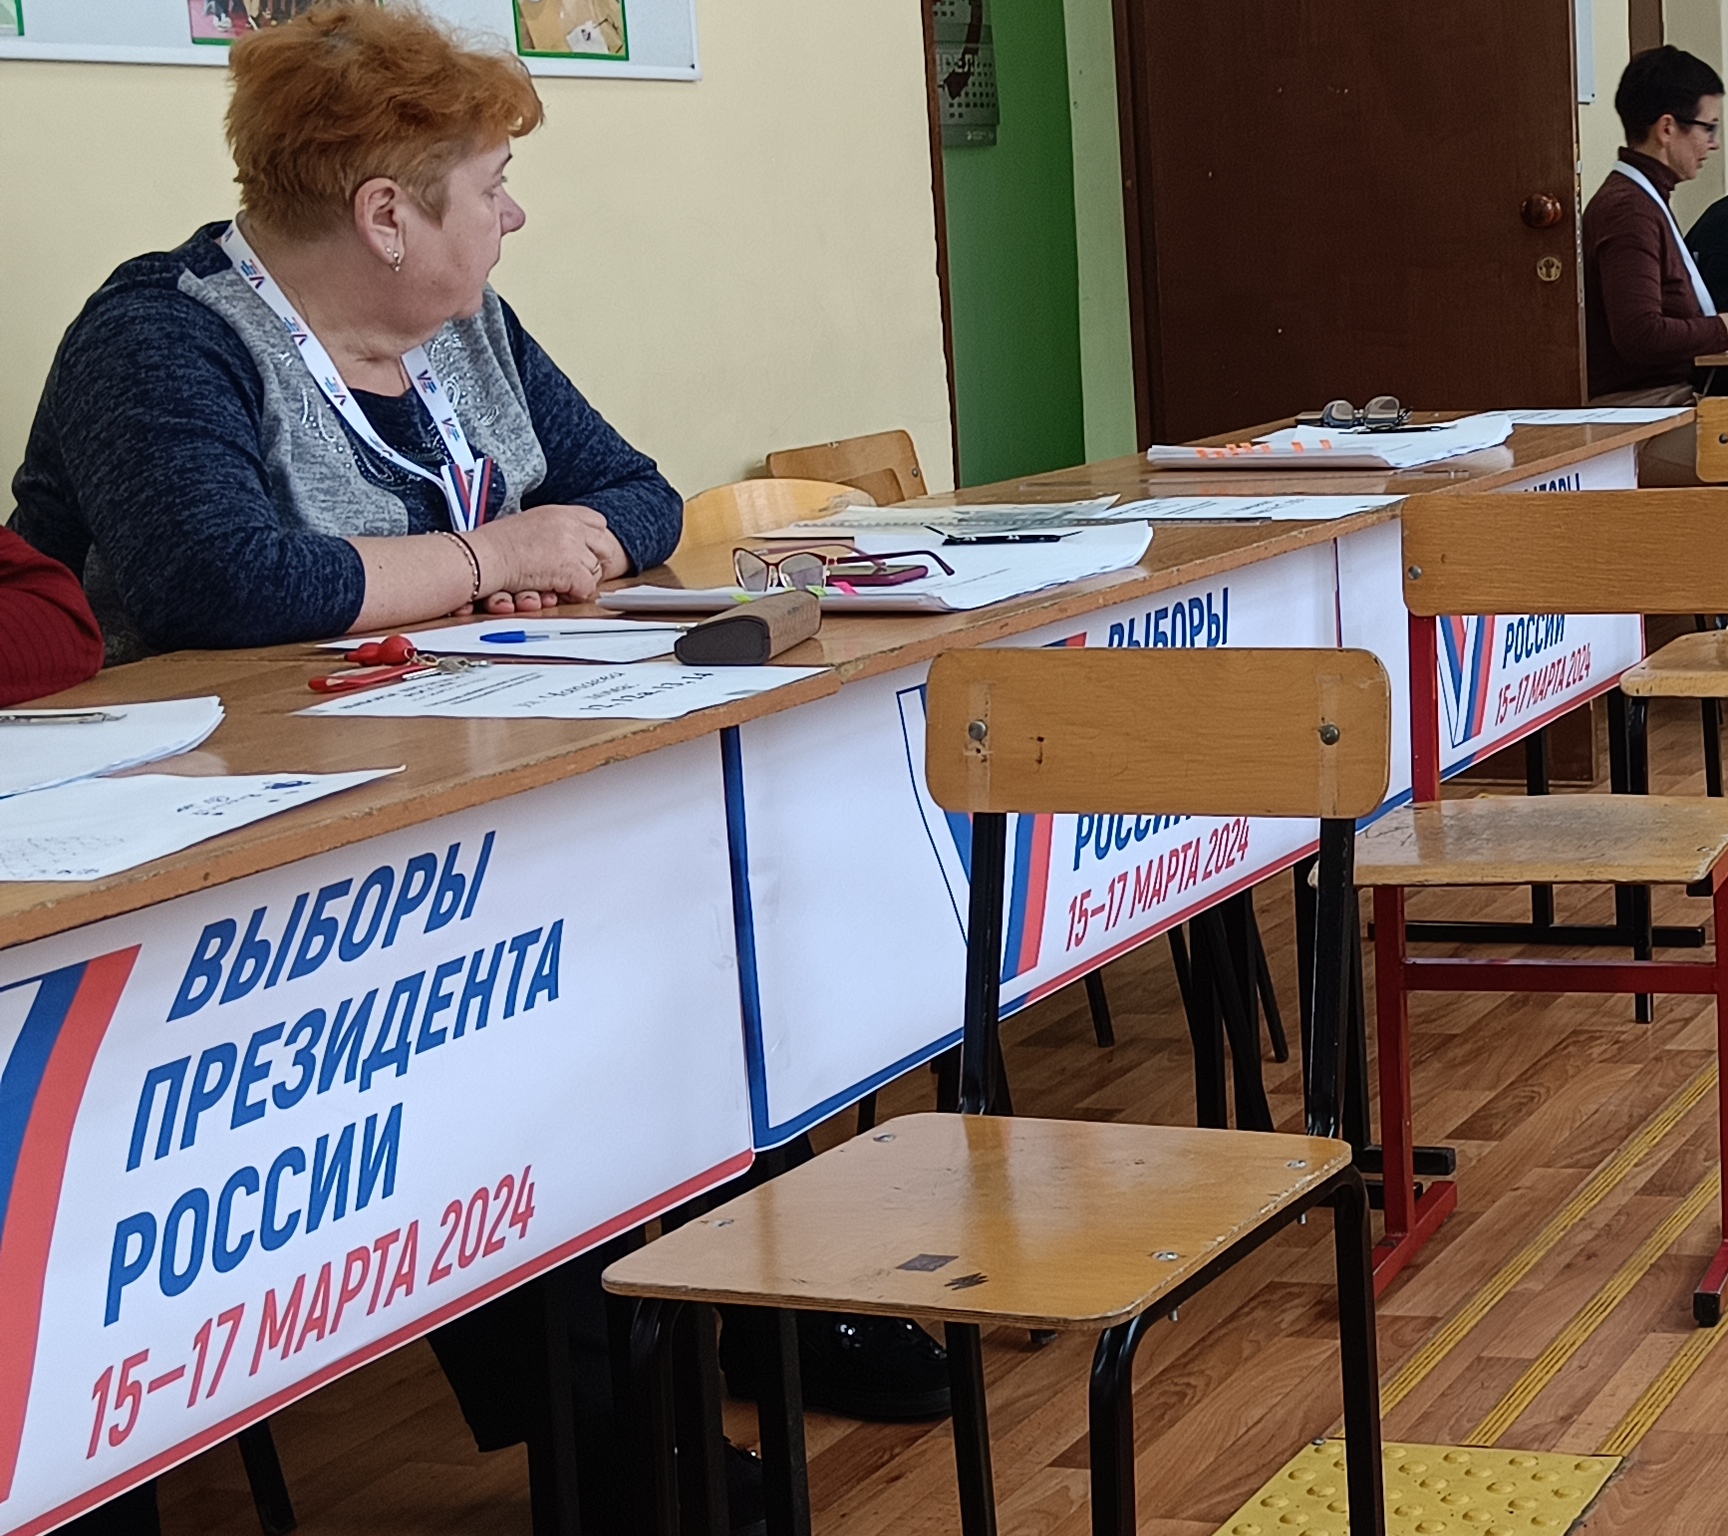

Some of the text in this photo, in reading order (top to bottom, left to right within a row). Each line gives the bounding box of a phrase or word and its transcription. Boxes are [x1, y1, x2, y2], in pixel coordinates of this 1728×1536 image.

[1526, 655, 1567, 710] МАРТА
[1565, 642, 1592, 689] 2024
[166, 830, 497, 1023] ВЫБОРЫ
[1128, 836, 1202, 920] МАРТА
[1201, 817, 1250, 883] 2024
[126, 919, 565, 1172] ПРЕЗИДЕНТА
[103, 1101, 404, 1328] РОССИИ
[249, 1219, 421, 1377] МАРТА
[427, 1165, 537, 1285] 2024
